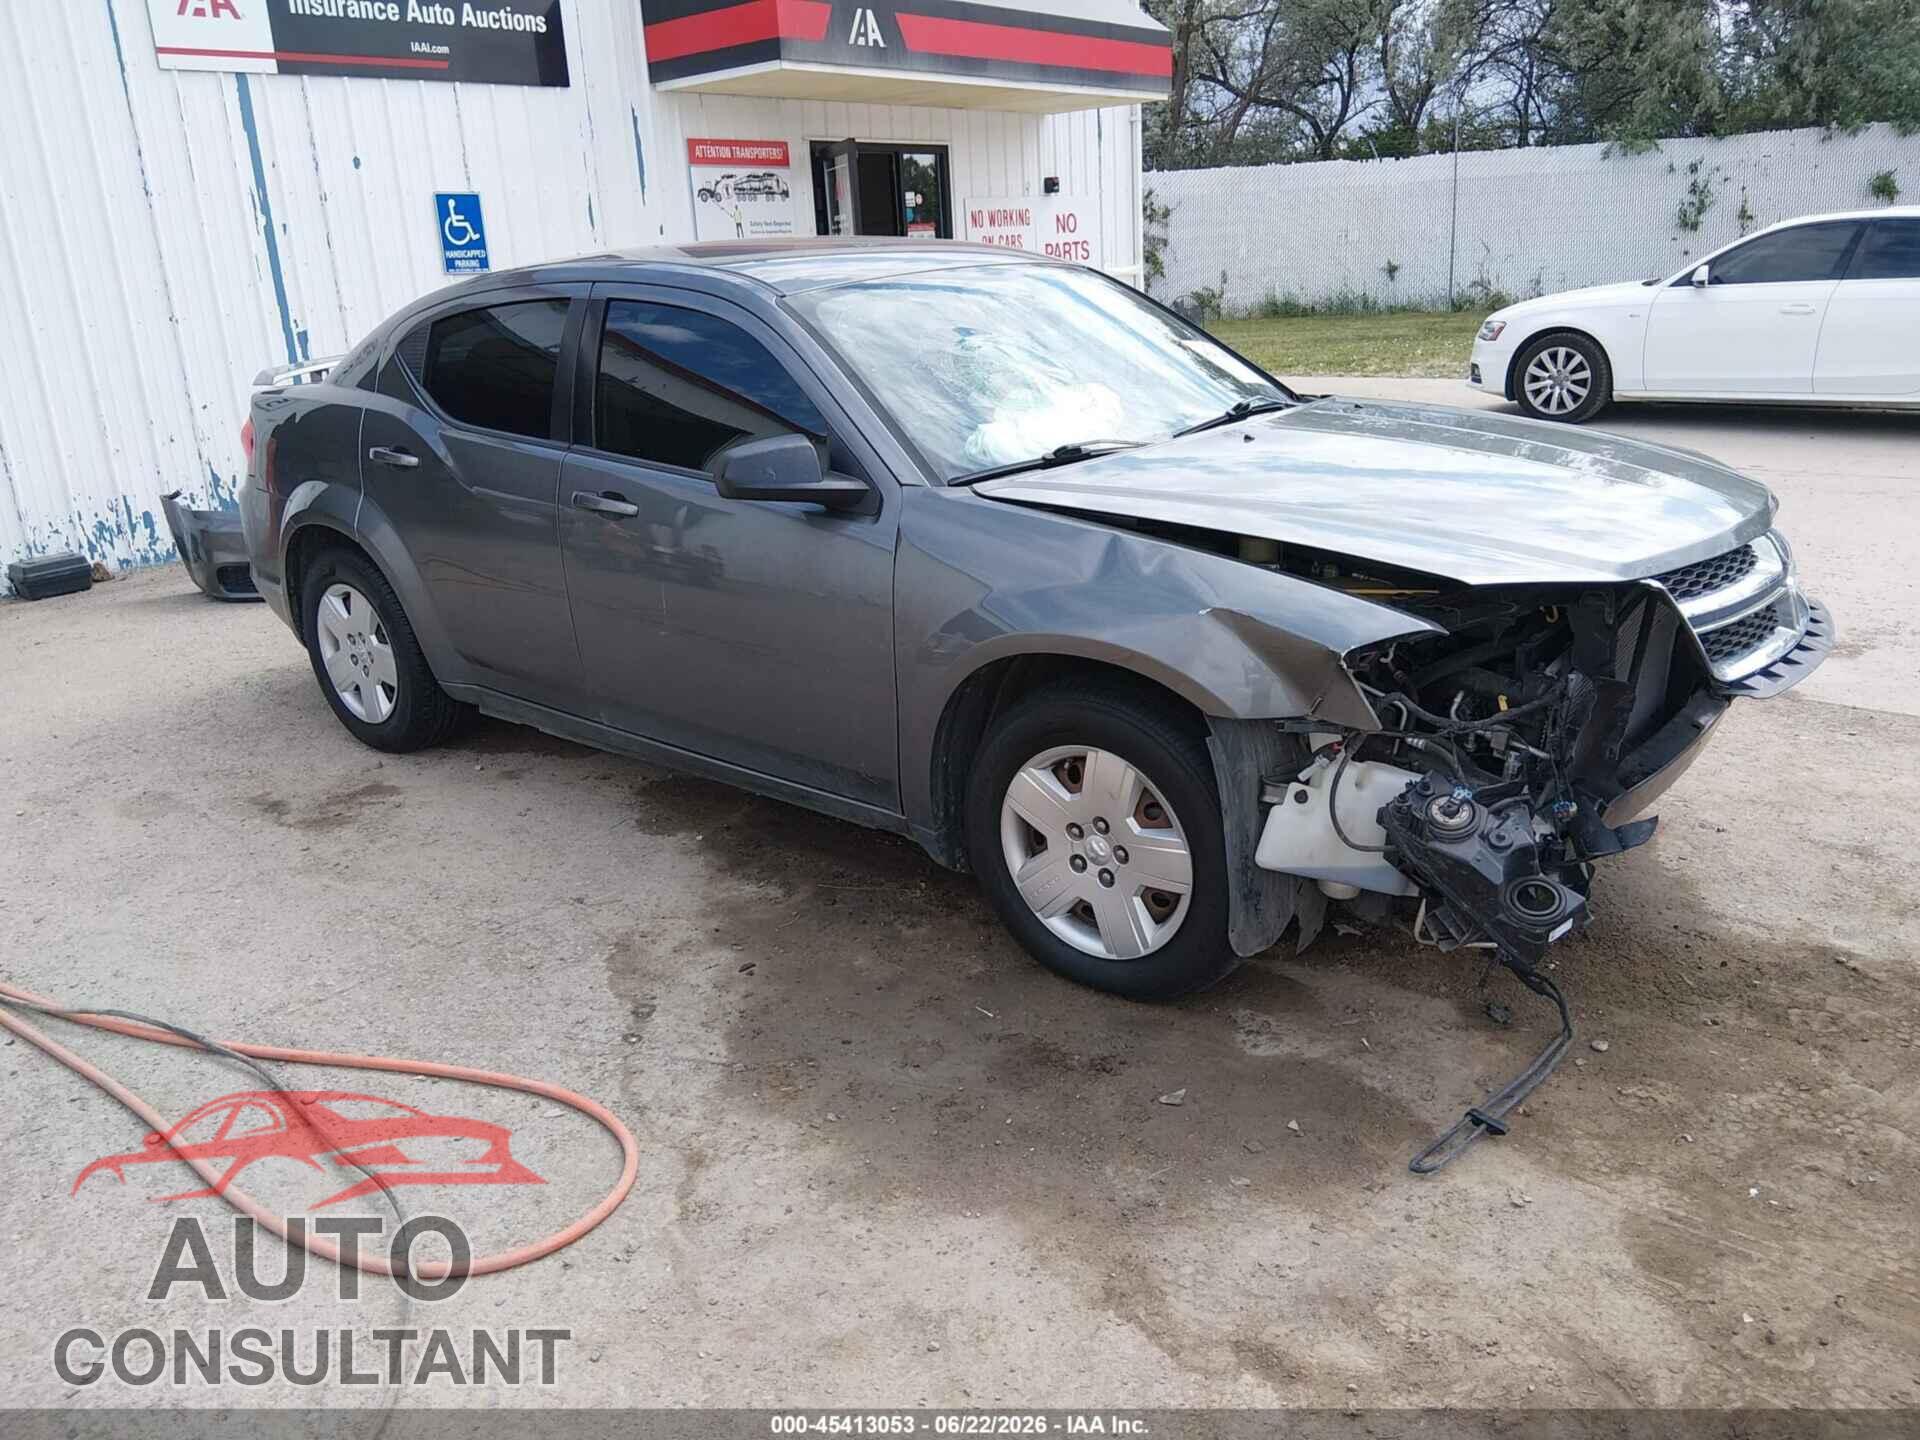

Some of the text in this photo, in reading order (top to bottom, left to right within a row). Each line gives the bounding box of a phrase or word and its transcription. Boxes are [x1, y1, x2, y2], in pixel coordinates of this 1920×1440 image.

[407, 0, 455, 25] Auto
[462, 3, 547, 33] Auctions
[411, 41, 450, 54] IAAI.com
[695, 145, 731, 159] ATTENTION
[970, 208, 1031, 228] NO WORKING
[1056, 213, 1077, 233] NO
[1045, 240, 1090, 260] PARTS
